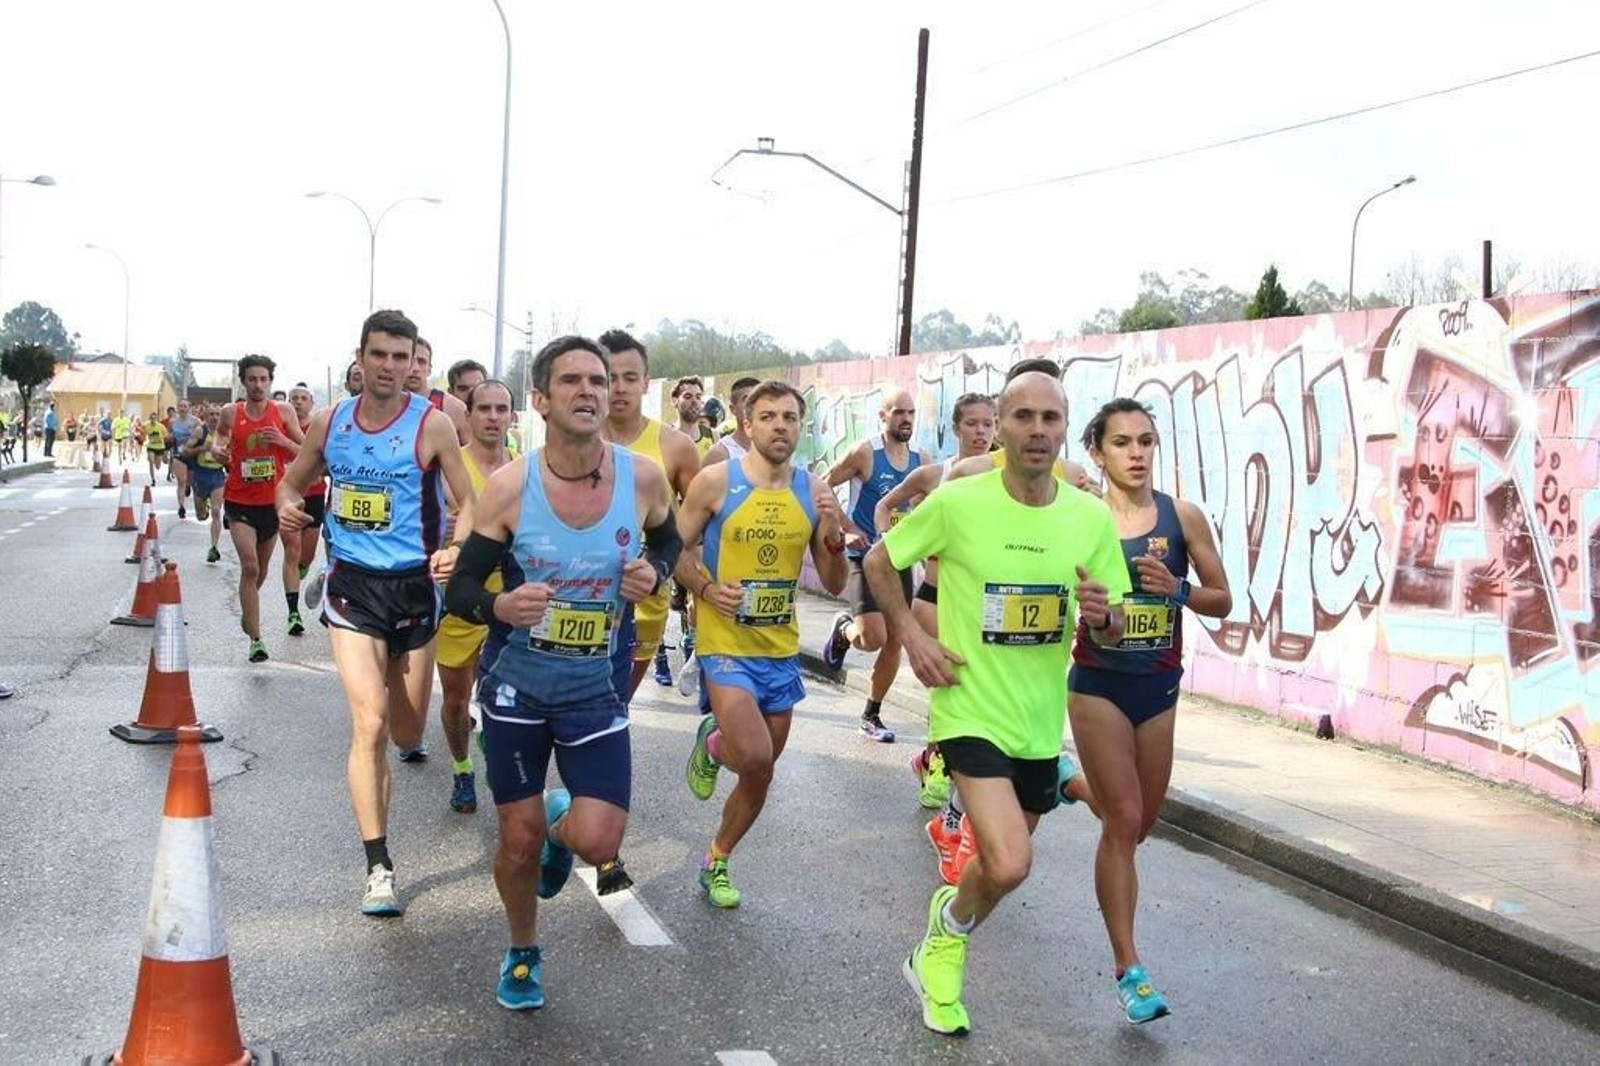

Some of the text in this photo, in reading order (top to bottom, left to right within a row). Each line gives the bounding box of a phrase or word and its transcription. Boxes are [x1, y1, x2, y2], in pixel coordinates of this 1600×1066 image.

[352, 499, 371, 518] 68
[756, 594, 785, 614] 1238
[1022, 604, 1040, 628] 12
[1125, 613, 1158, 634] 1164
[558, 618, 596, 641] 1210
